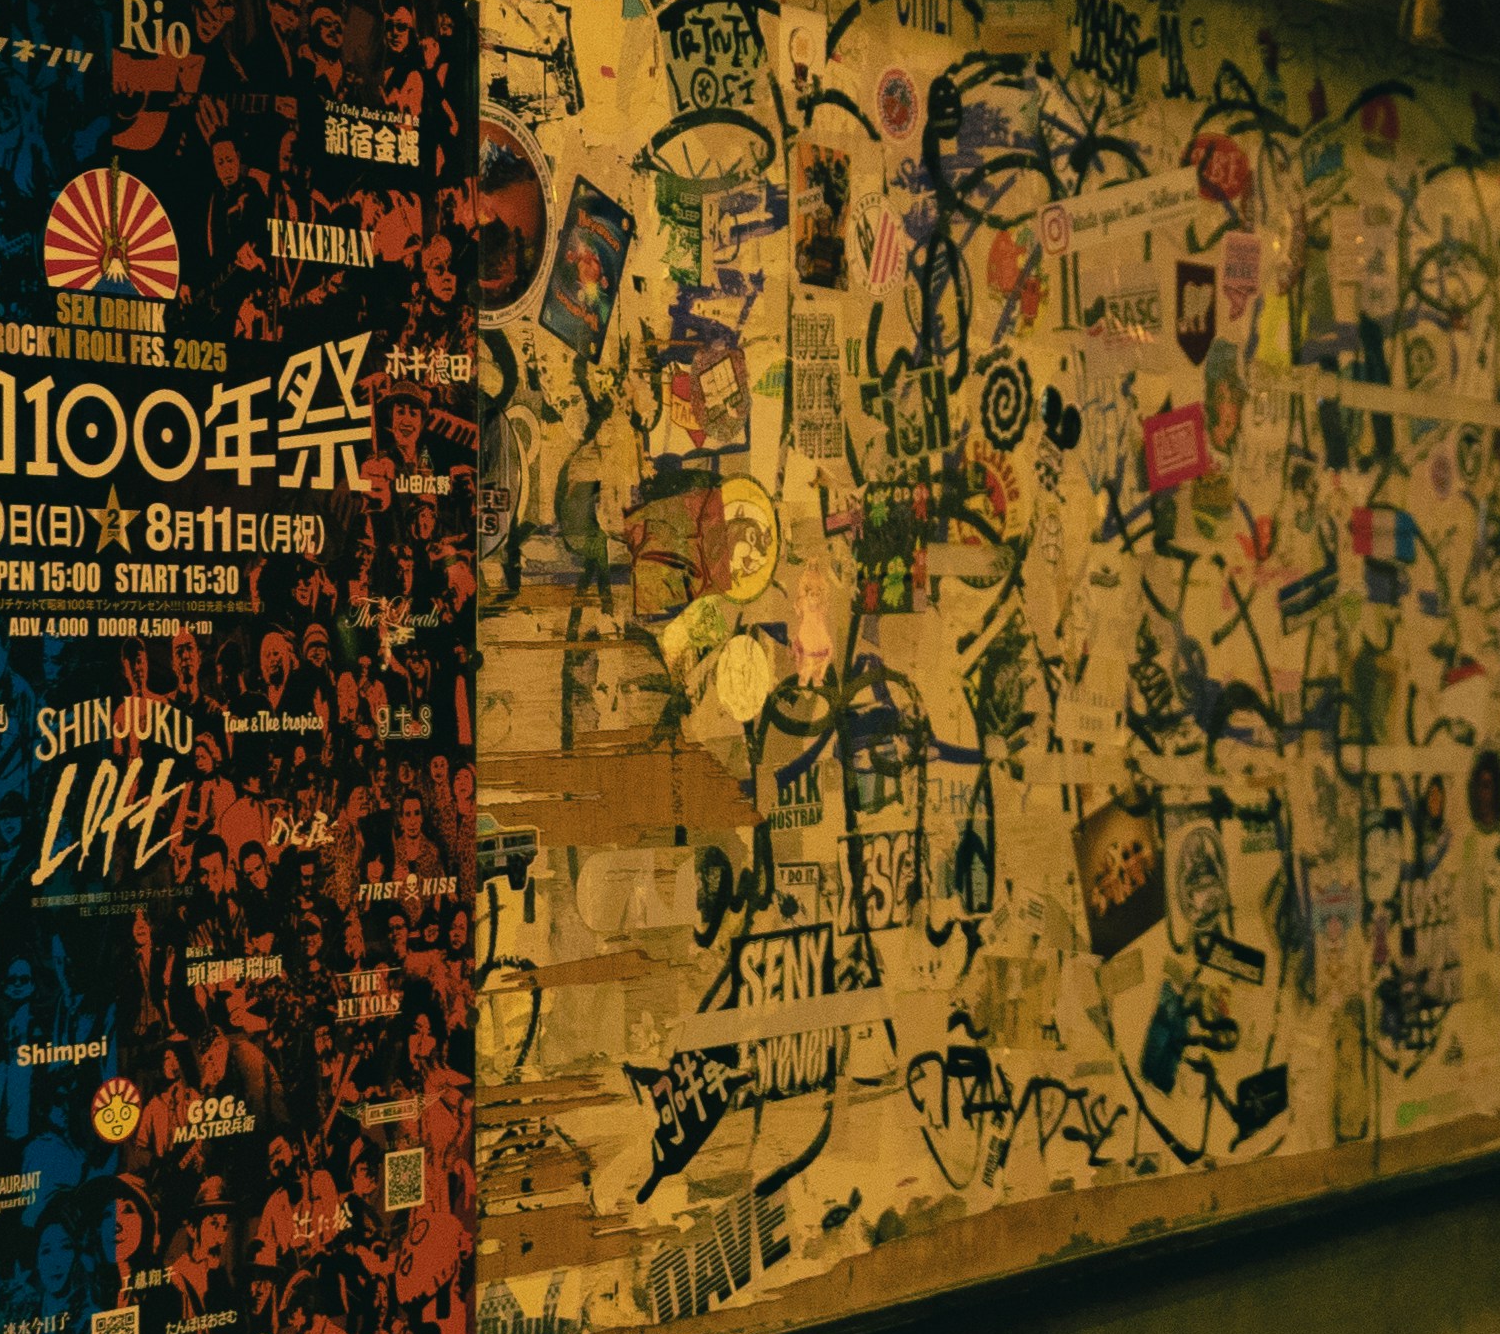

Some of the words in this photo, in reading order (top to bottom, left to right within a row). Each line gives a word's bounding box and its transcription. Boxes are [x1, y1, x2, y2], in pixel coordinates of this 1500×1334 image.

[266, 217, 376, 269] TAKEBAN
[56, 291, 97, 328] SEX
[100, 298, 168, 335] DRINK
[76, 327, 126, 365] ROLL
[129, 330, 170, 368] FES.
[173, 337, 228, 373] 2025
[384, 342, 473, 384] ホキ徳田
[394, 475, 452, 496] 山田広野
[145, 499, 326, 555] 8月11日(月祝)
[40, 560, 100, 595] 15:00
[114, 562, 179, 596] START
[183, 563, 240, 597] 15:30
[8, 616, 43, 638] ADV.
[45, 617, 89, 640] 4,000
[97, 617, 137, 638] DOOR
[139, 617, 181, 639] 4,500
[34, 696, 194, 763] SHINJUKU
[283, 708, 324, 735] tropics
[358, 880, 403, 902] FIRST
[422, 876, 457, 896] KISS
[348, 971, 383, 995] THE
[16, 1034, 109, 1069] Shimpei
[186, 1094, 247, 1124] G9G&
